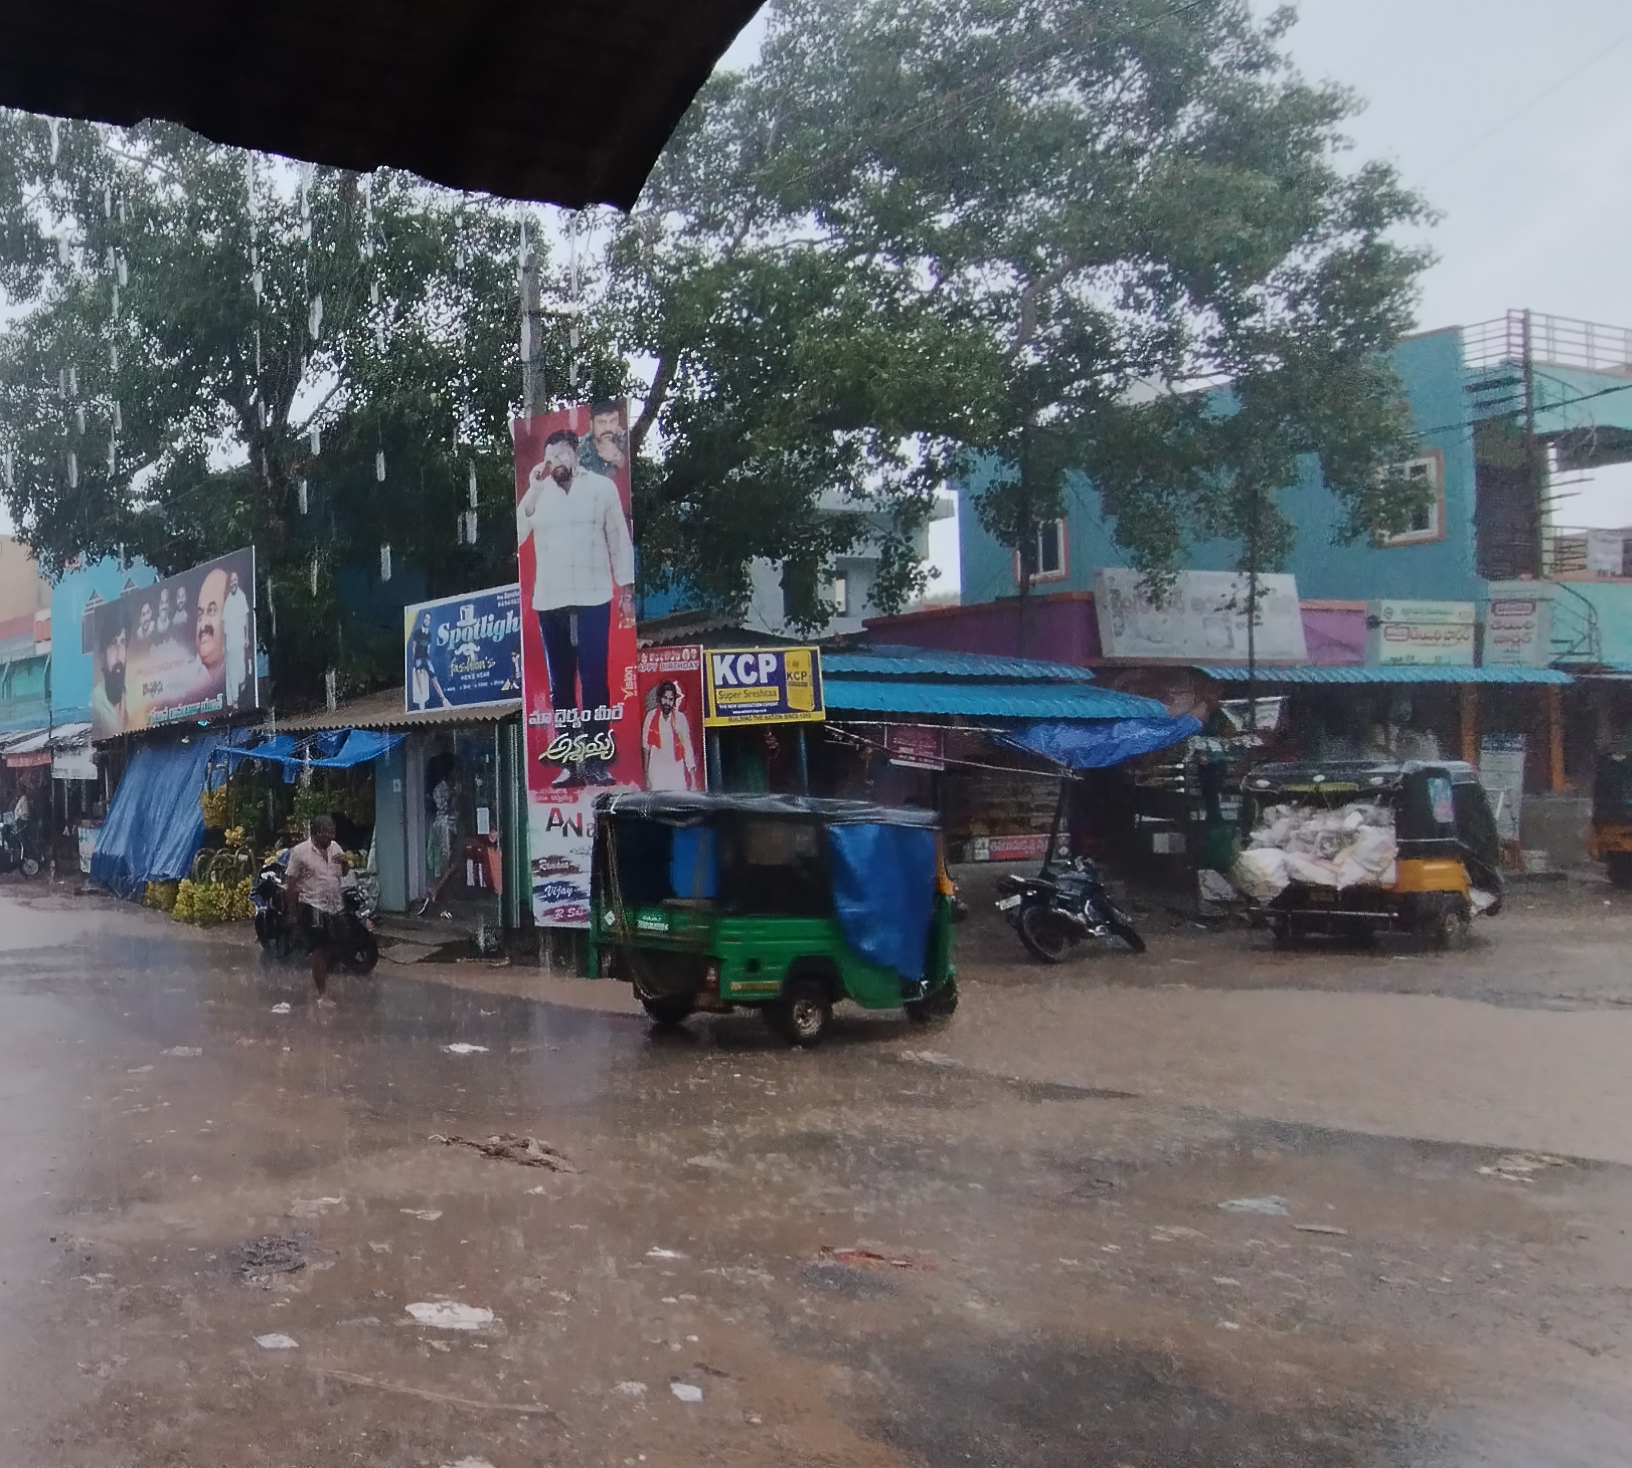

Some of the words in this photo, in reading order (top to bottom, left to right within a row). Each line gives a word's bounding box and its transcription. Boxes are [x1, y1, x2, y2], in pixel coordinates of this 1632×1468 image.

[436, 609, 520, 650] Spotligh
[638, 663, 658, 673] APPY
[659, 660, 700, 672] BIRTHDAY
[712, 653, 777, 686] KCP
[787, 671, 807, 681] KCP
[718, 690, 742, 701] Super
[528, 710, 552, 725] మా
[544, 885, 573, 899] Vijay
